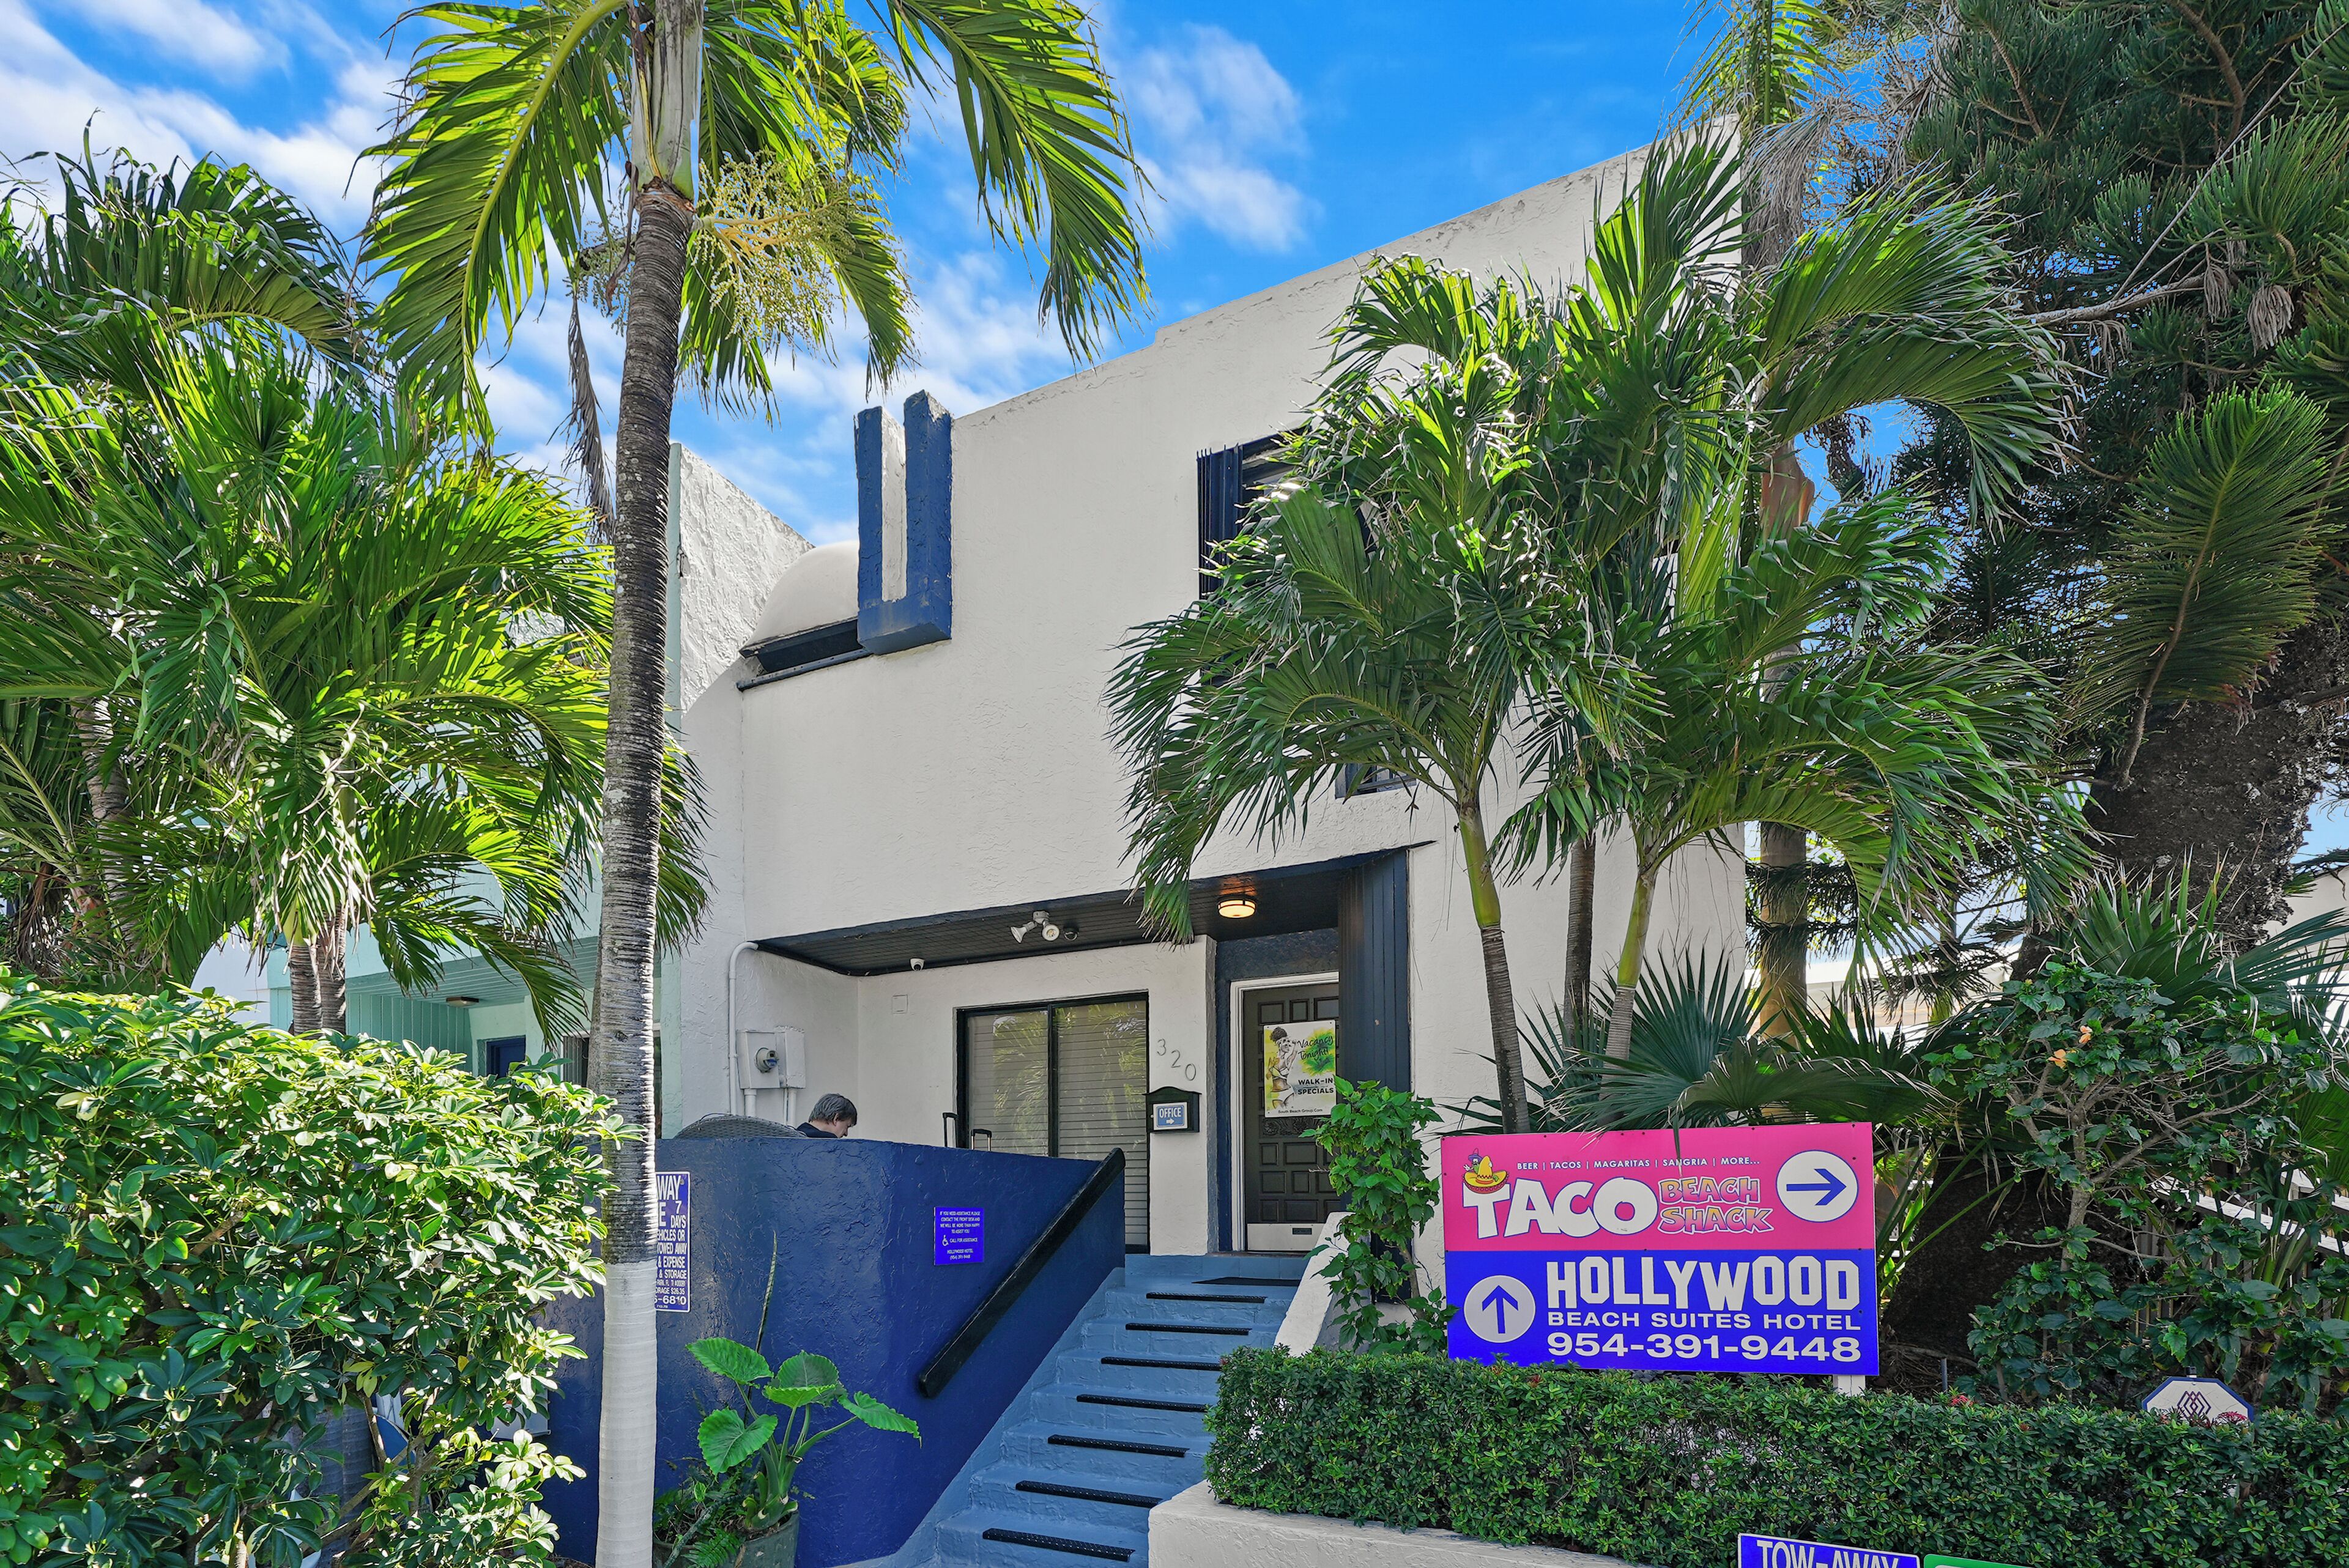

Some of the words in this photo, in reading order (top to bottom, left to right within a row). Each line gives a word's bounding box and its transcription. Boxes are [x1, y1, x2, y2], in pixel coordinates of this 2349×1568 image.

[1297, 1036, 1334, 1048] Vacancy
[1157, 1038, 1196, 1081] 320
[1159, 1106, 1182, 1119] OFFICE
[656, 1175, 681, 1200] WAY
[1659, 1176, 1761, 1205] BEACH
[675, 1200, 682, 1214] 7
[1462, 1177, 1658, 1240] TACO
[670, 1215, 686, 1228] DAYS
[1658, 1205, 1773, 1234] SHACK
[657, 1229, 677, 1241] EHICLES
[677, 1229, 685, 1241] OR
[675, 1243, 687, 1254] AWAY
[658, 1256, 662, 1268] &
[663, 1256, 685, 1268] EXPENSE
[659, 1269, 662, 1278] &
[664, 1269, 687, 1279] STORAGE
[1546, 1256, 1860, 1311] HOLLYWOOD
[1548, 1311, 1640, 1327] BEACH
[1651, 1312, 1751, 1329] SUITES
[1764, 1314, 1861, 1330] HOTEL
[1547, 1333, 1861, 1362] 954-391-9448
[1756, 1539, 1899, 1568] TOW-
